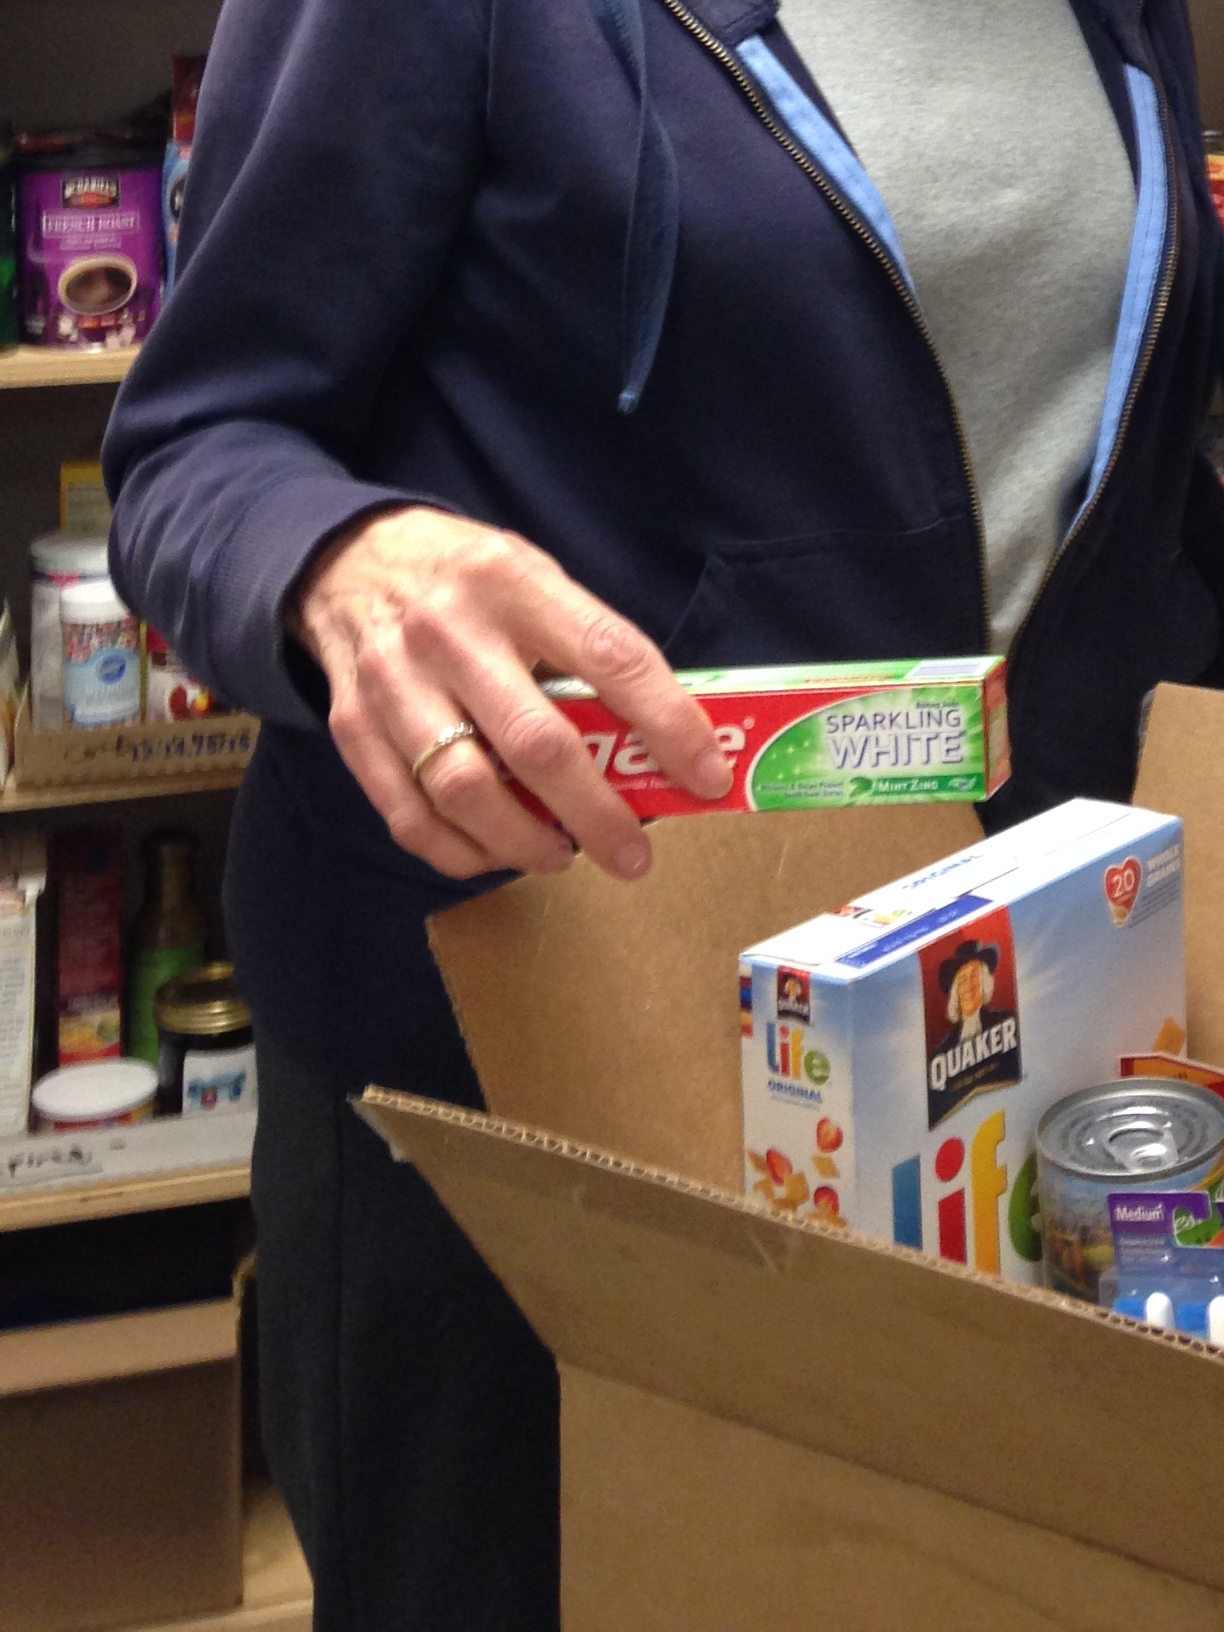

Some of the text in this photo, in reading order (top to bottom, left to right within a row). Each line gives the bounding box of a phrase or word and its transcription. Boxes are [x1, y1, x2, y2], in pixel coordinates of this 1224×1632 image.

[826, 709, 962, 734] SPARKLING
[828, 731, 966, 770] WHITE
[1113, 869, 1135, 899] 20
[765, 1021, 831, 1086] life
[929, 1017, 1018, 1092] QUAKER
[768, 1079, 823, 1104] ORIGINAL
[1114, 1203, 1166, 1222] Medium
